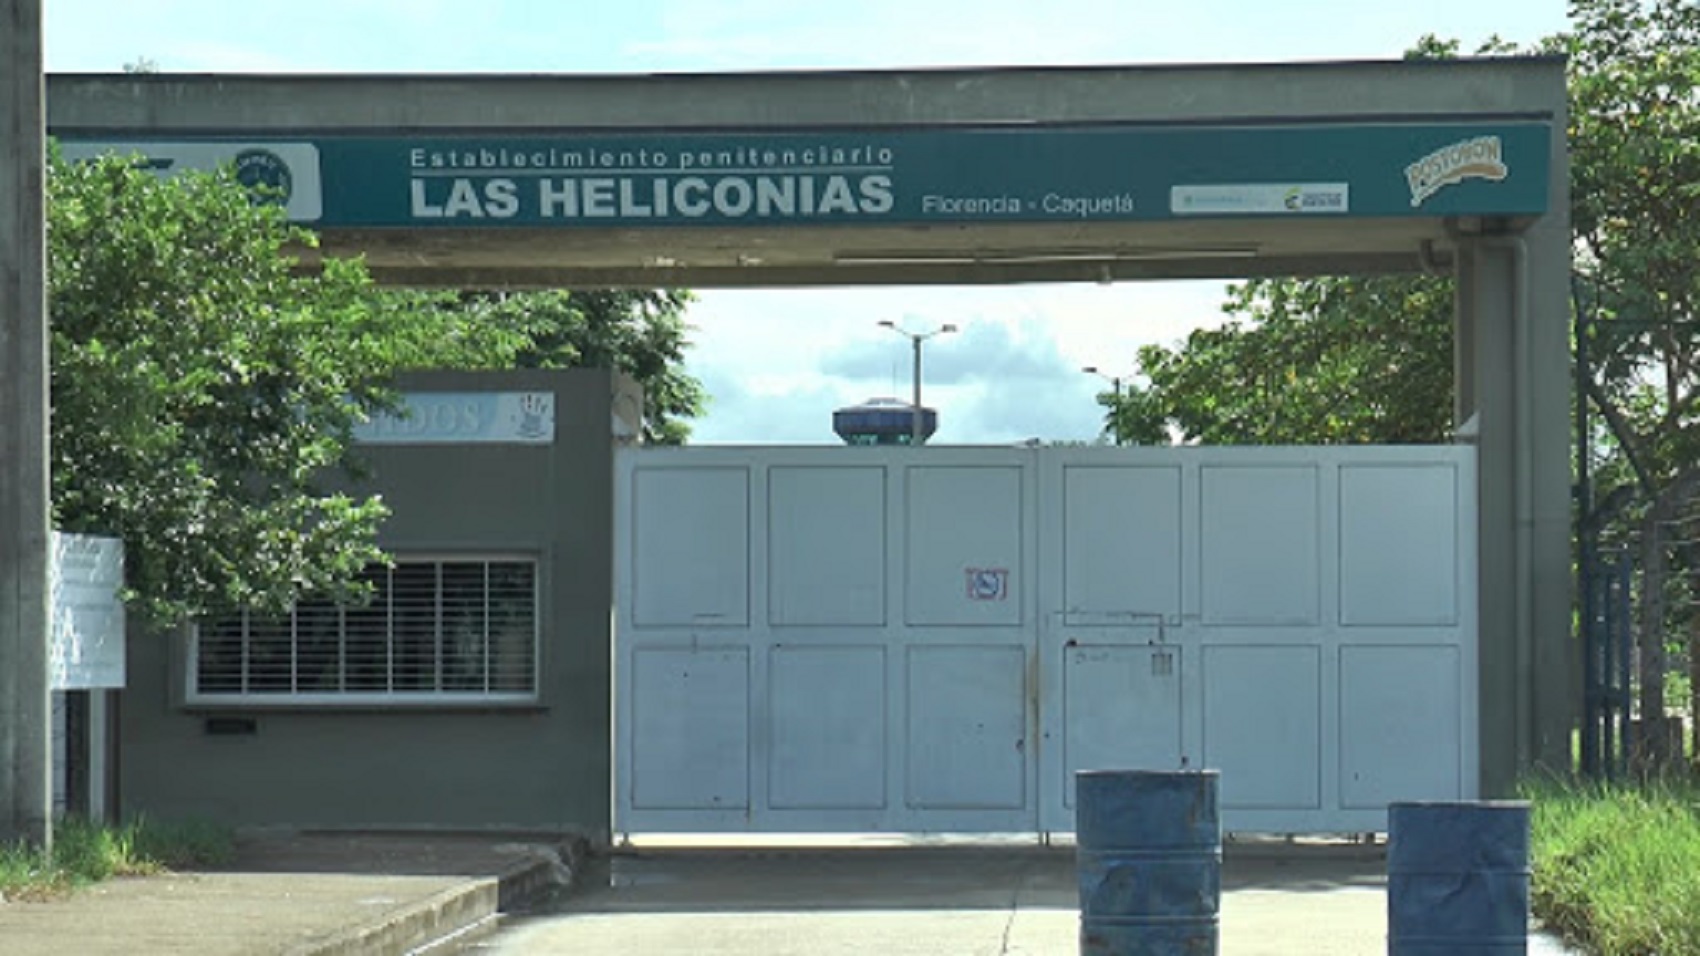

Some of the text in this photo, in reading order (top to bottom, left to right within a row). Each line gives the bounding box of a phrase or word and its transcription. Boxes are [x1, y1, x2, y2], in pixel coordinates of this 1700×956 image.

[410, 146, 893, 170] Establecimiento penitenciario
[410, 174, 895, 218] LAS HELICONIAS
[921, 194, 1021, 213] Florencia
[1043, 193, 1133, 218] Caquetá
